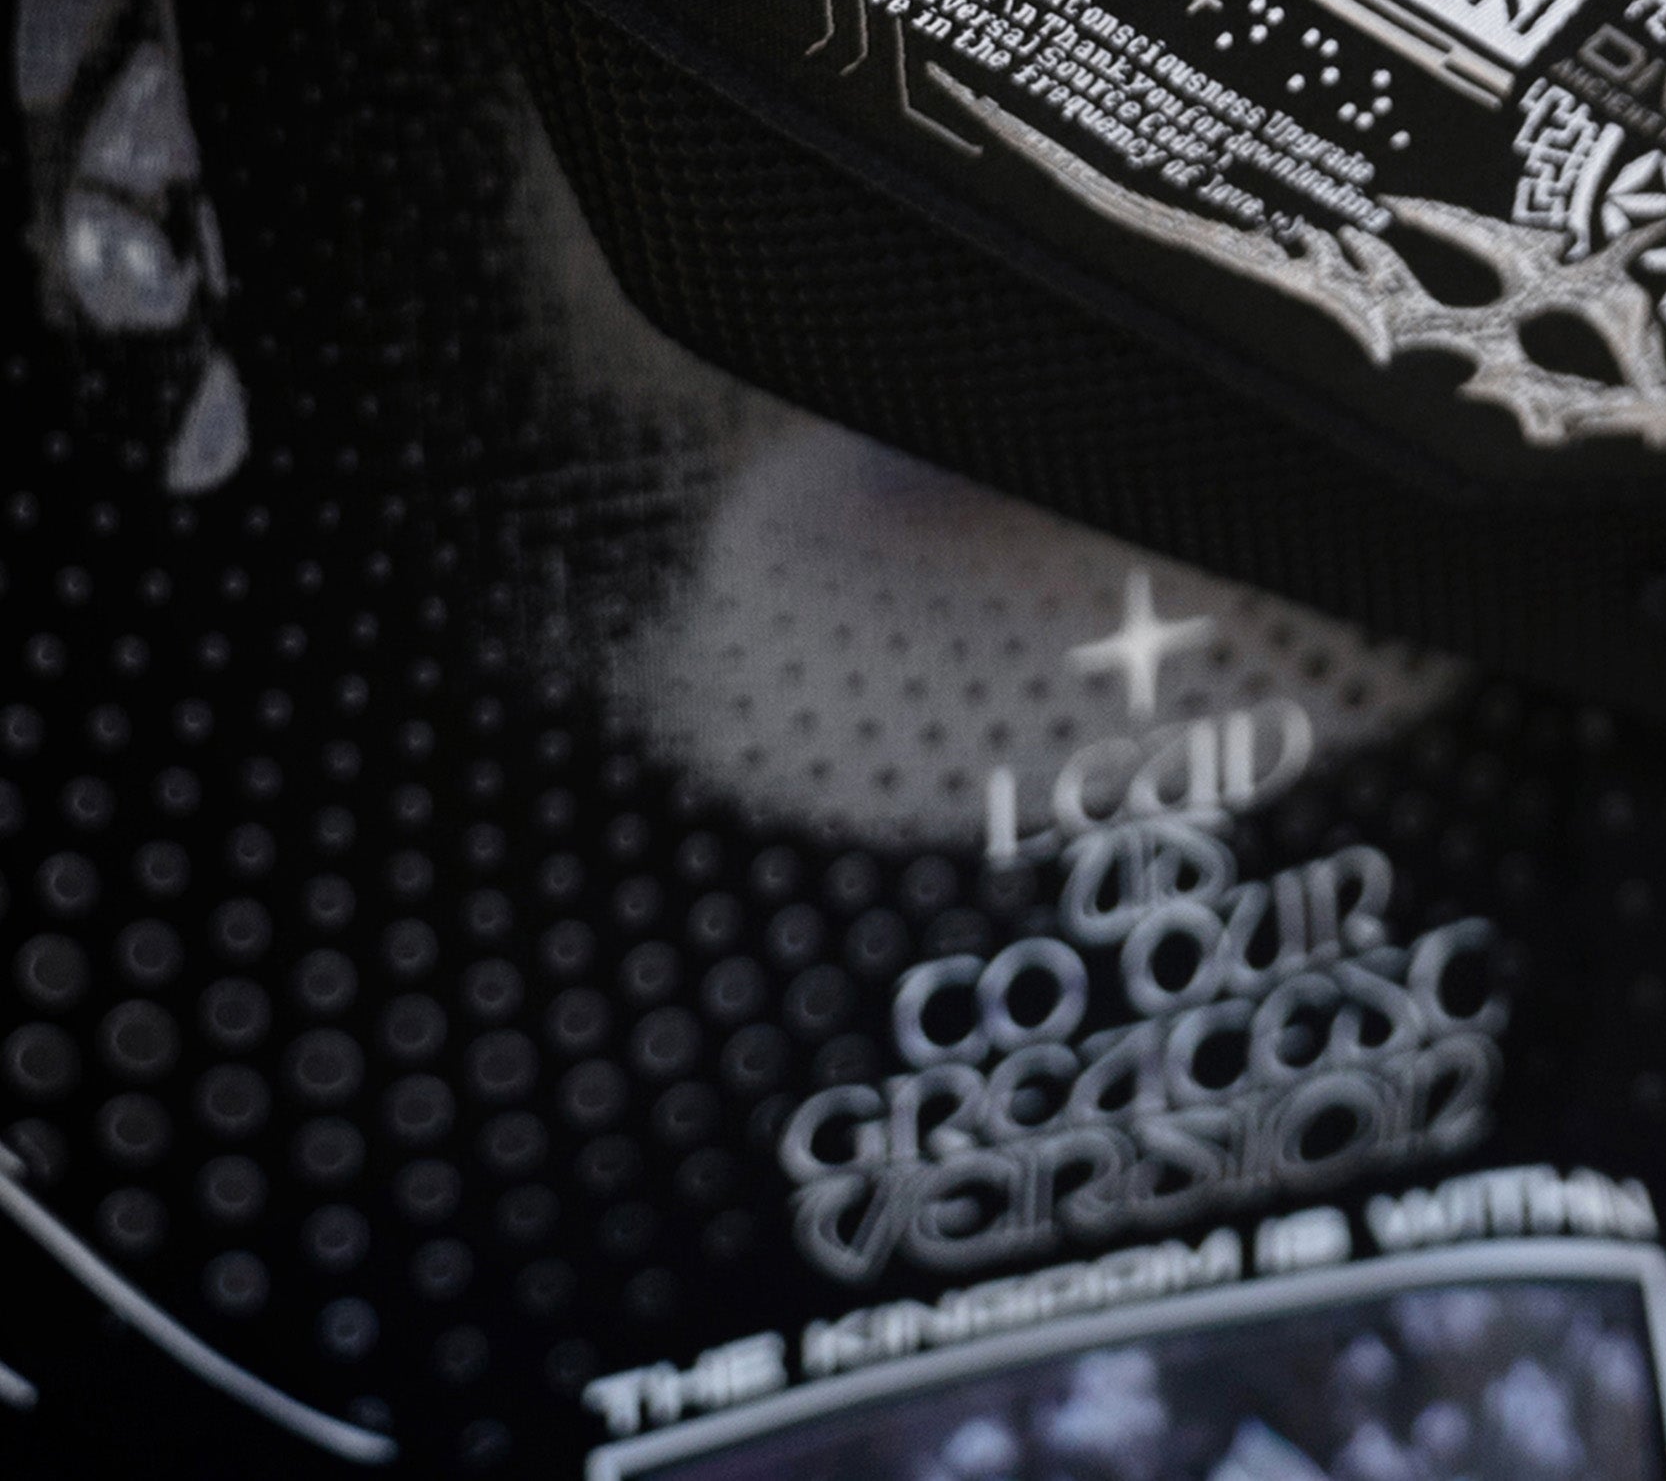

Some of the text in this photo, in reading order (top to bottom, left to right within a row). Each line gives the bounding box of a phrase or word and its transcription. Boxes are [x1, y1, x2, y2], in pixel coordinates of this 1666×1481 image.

[912, 6, 953, 39] in
[953, 26, 1012, 68] the
[1013, 64, 1169, 167] frequency
[1162, 149, 1205, 186] of
[1033, 47, 1143, 118] Source
[1224, 118, 1393, 233] downloading
[1266, 111, 1375, 185] Upgrade
[585, 1331, 790, 1434] THE
